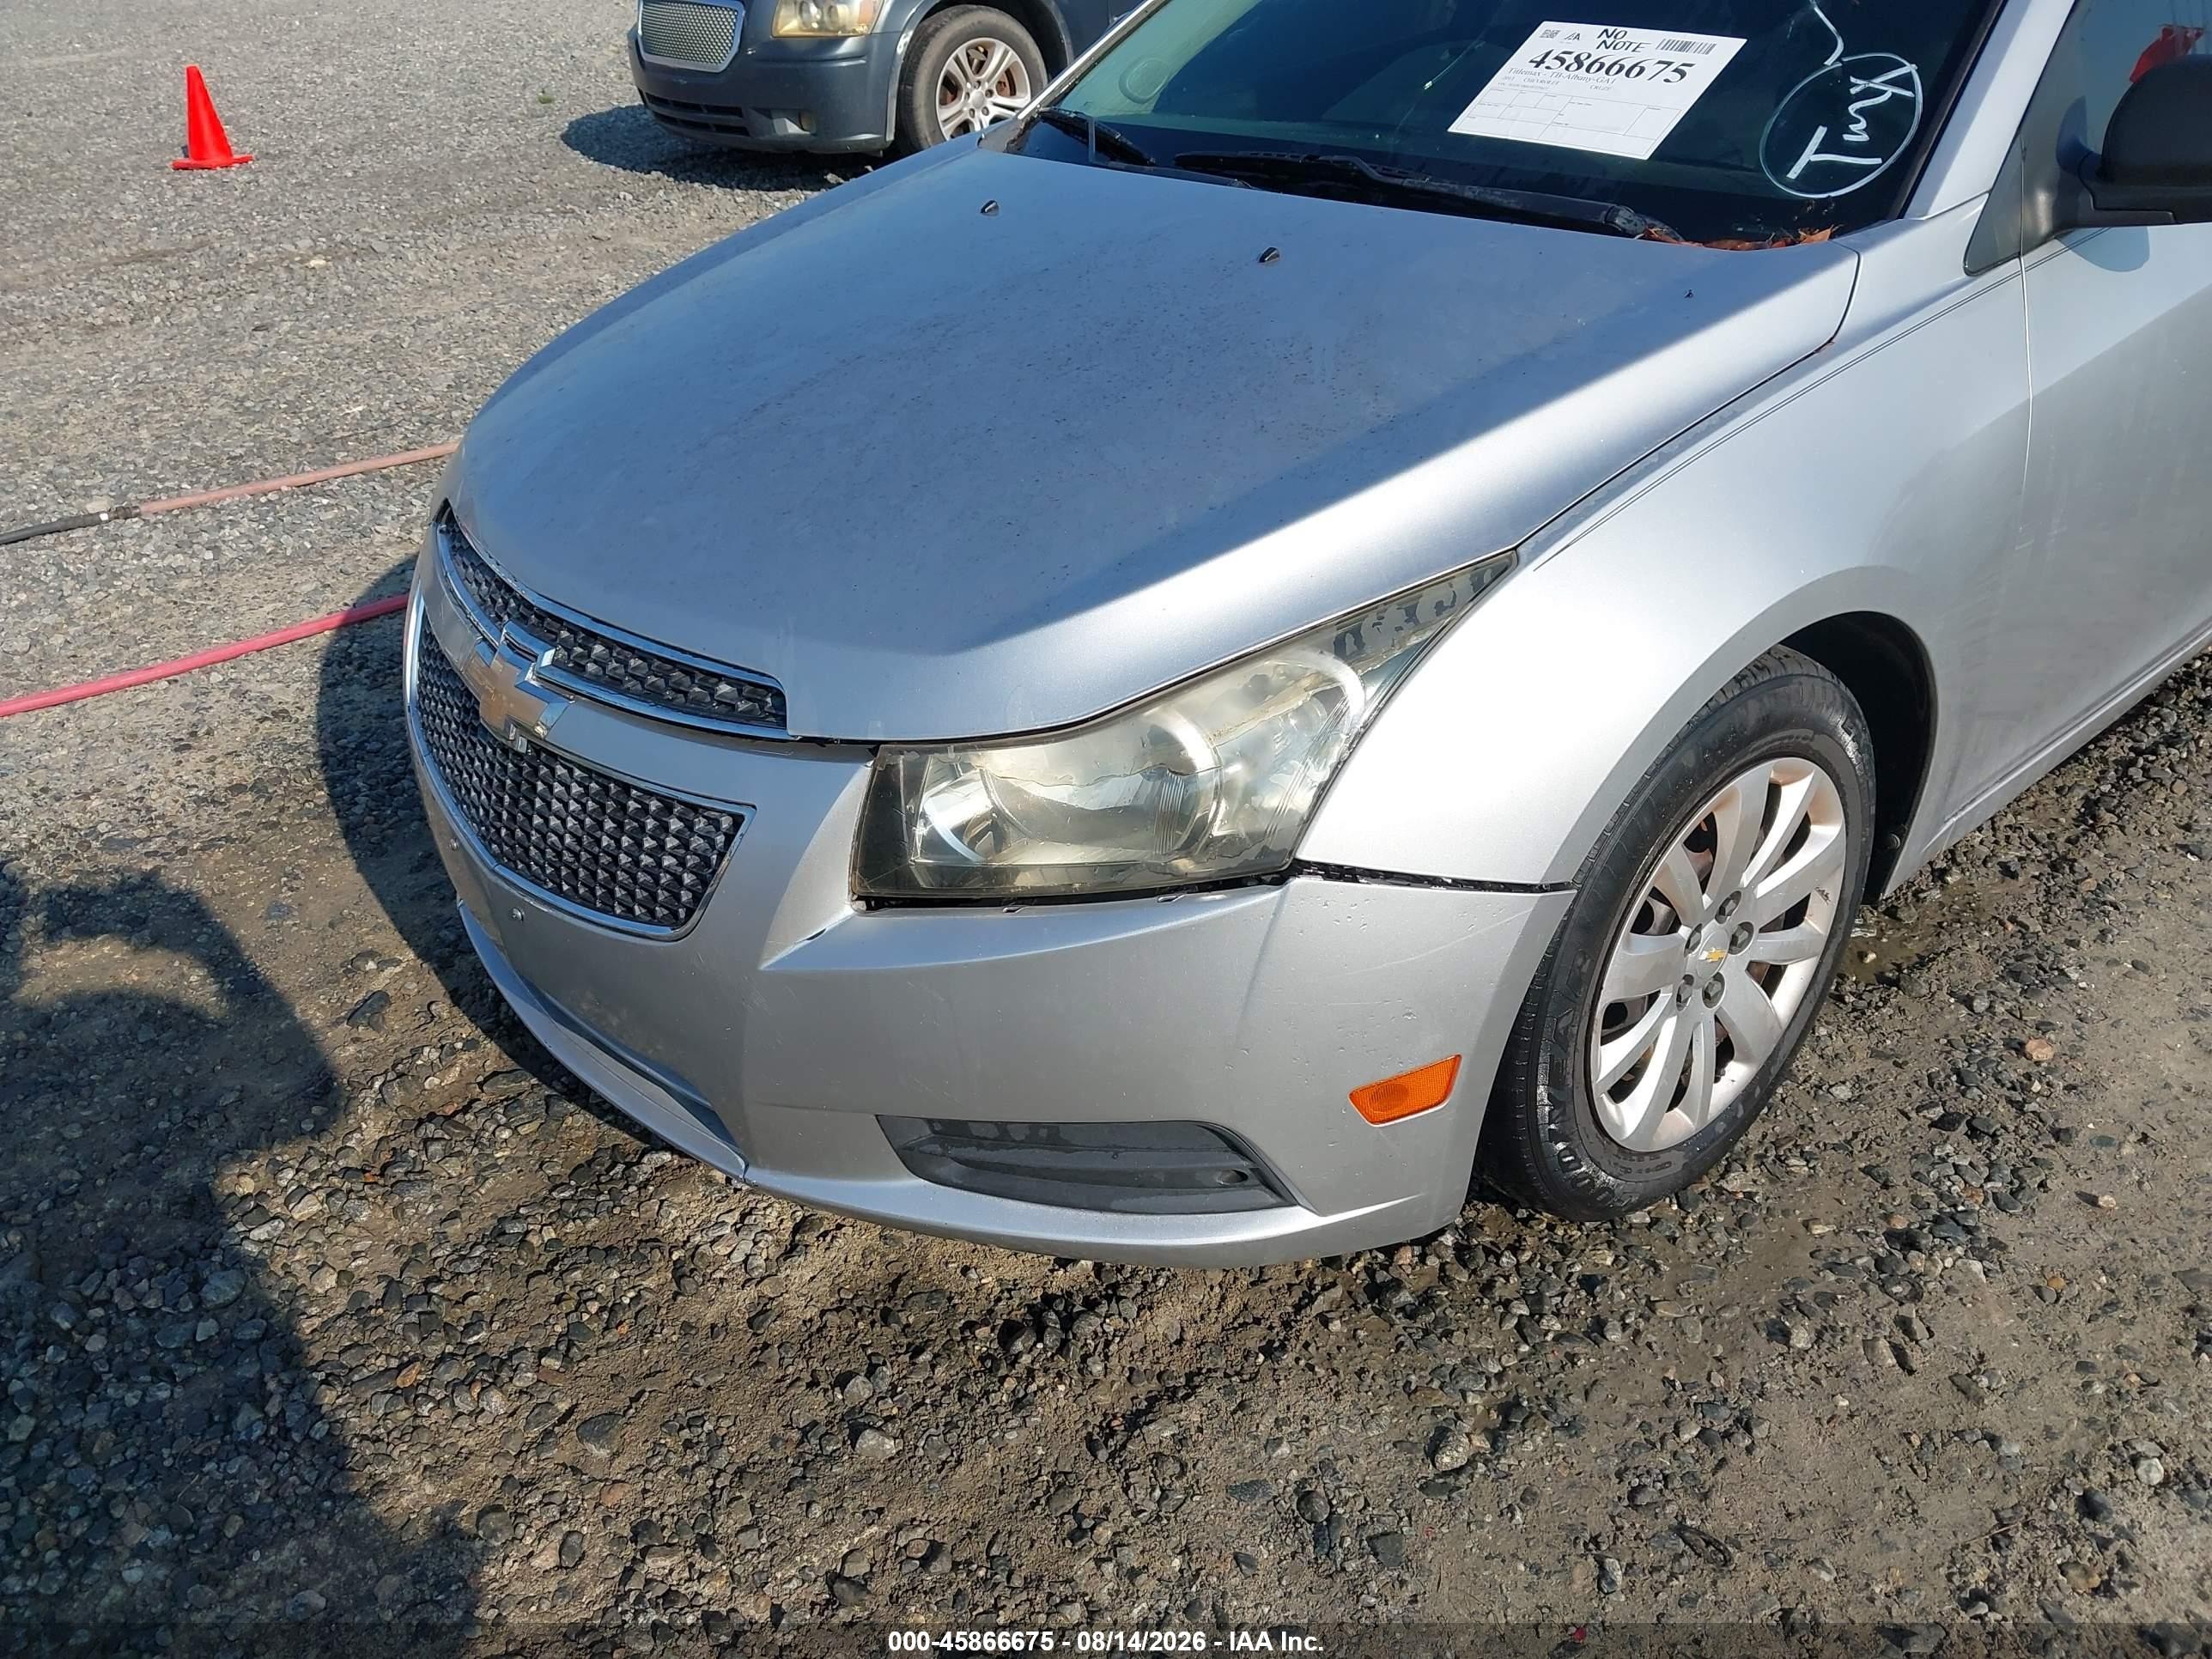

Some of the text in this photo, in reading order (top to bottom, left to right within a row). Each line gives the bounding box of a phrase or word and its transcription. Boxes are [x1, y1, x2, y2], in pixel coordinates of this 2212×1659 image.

[1596, 27, 1628, 40] NO
[1595, 40, 1652, 52] NOTE
[1528, 48, 1697, 83] 45866675
